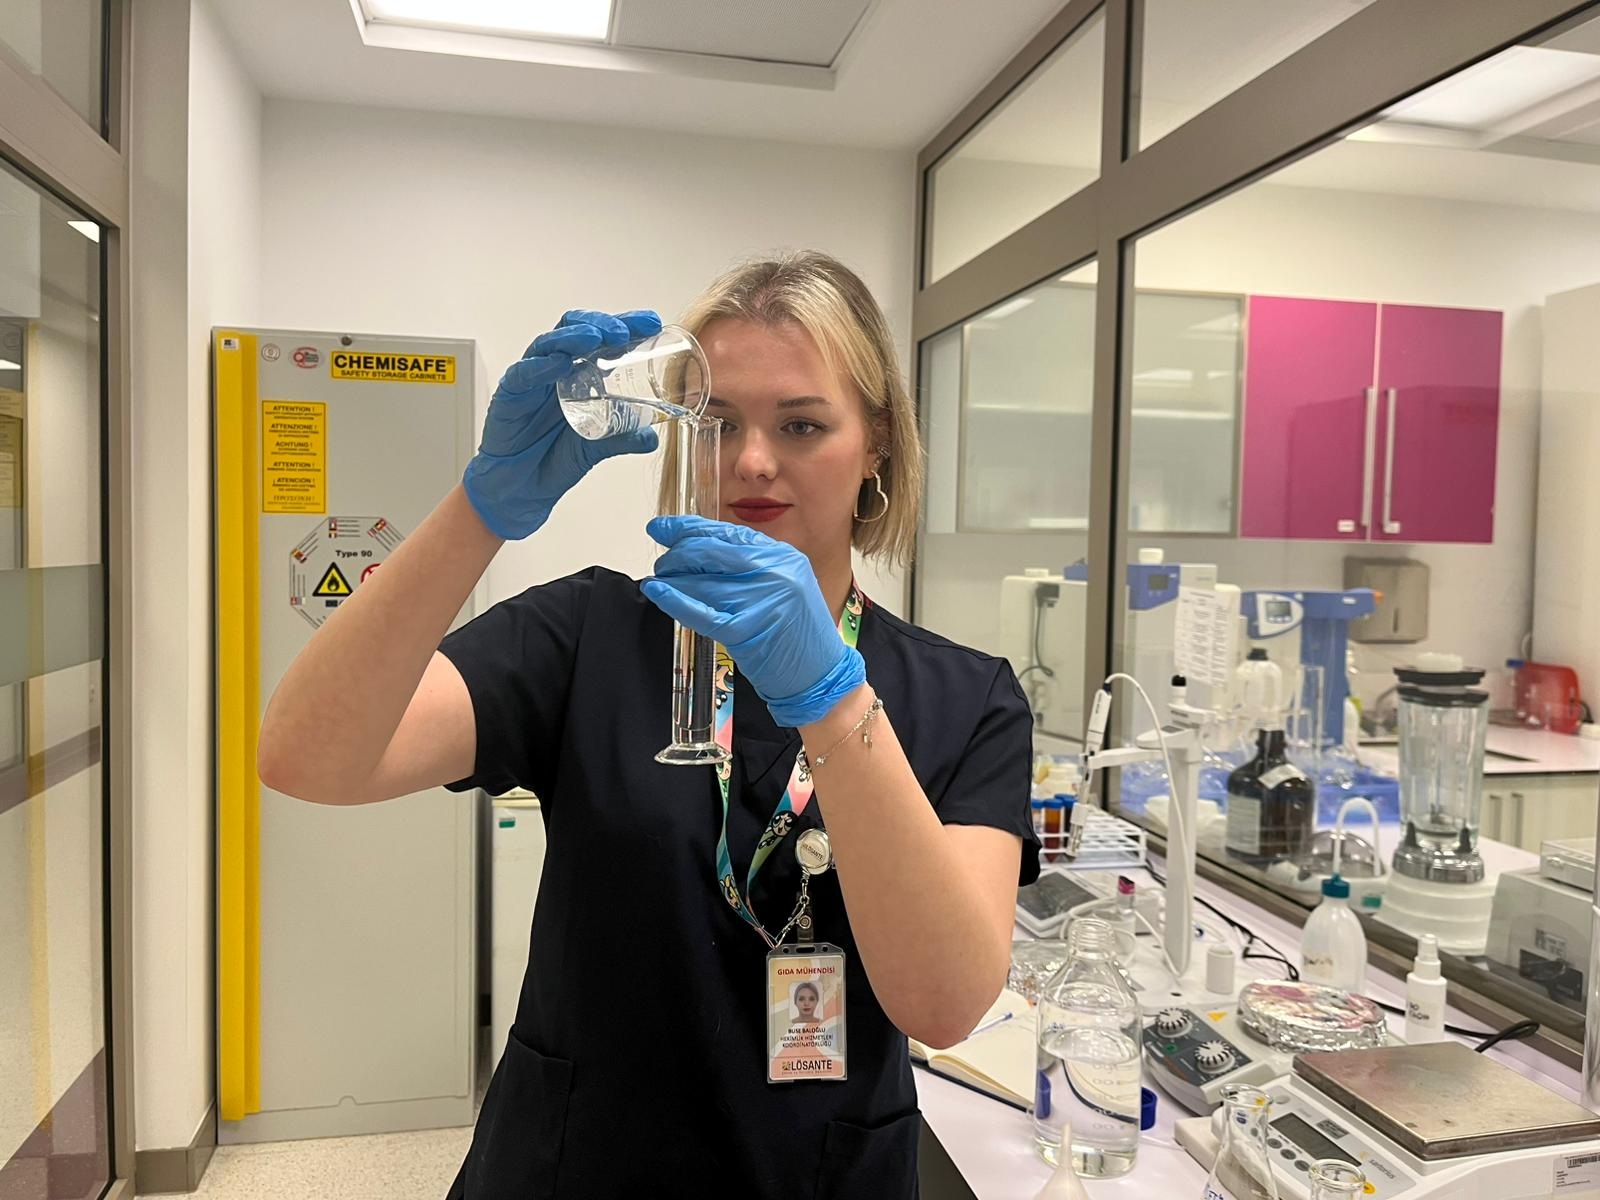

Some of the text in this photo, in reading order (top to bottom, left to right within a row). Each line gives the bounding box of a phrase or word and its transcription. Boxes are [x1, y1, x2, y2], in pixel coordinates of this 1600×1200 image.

[334, 354, 447, 372] CHEMISAFE
[336, 550, 358, 558] Type
[796, 965, 835, 974] MÜHENDİSİ
[791, 1059, 832, 1071] LÖSANTE
